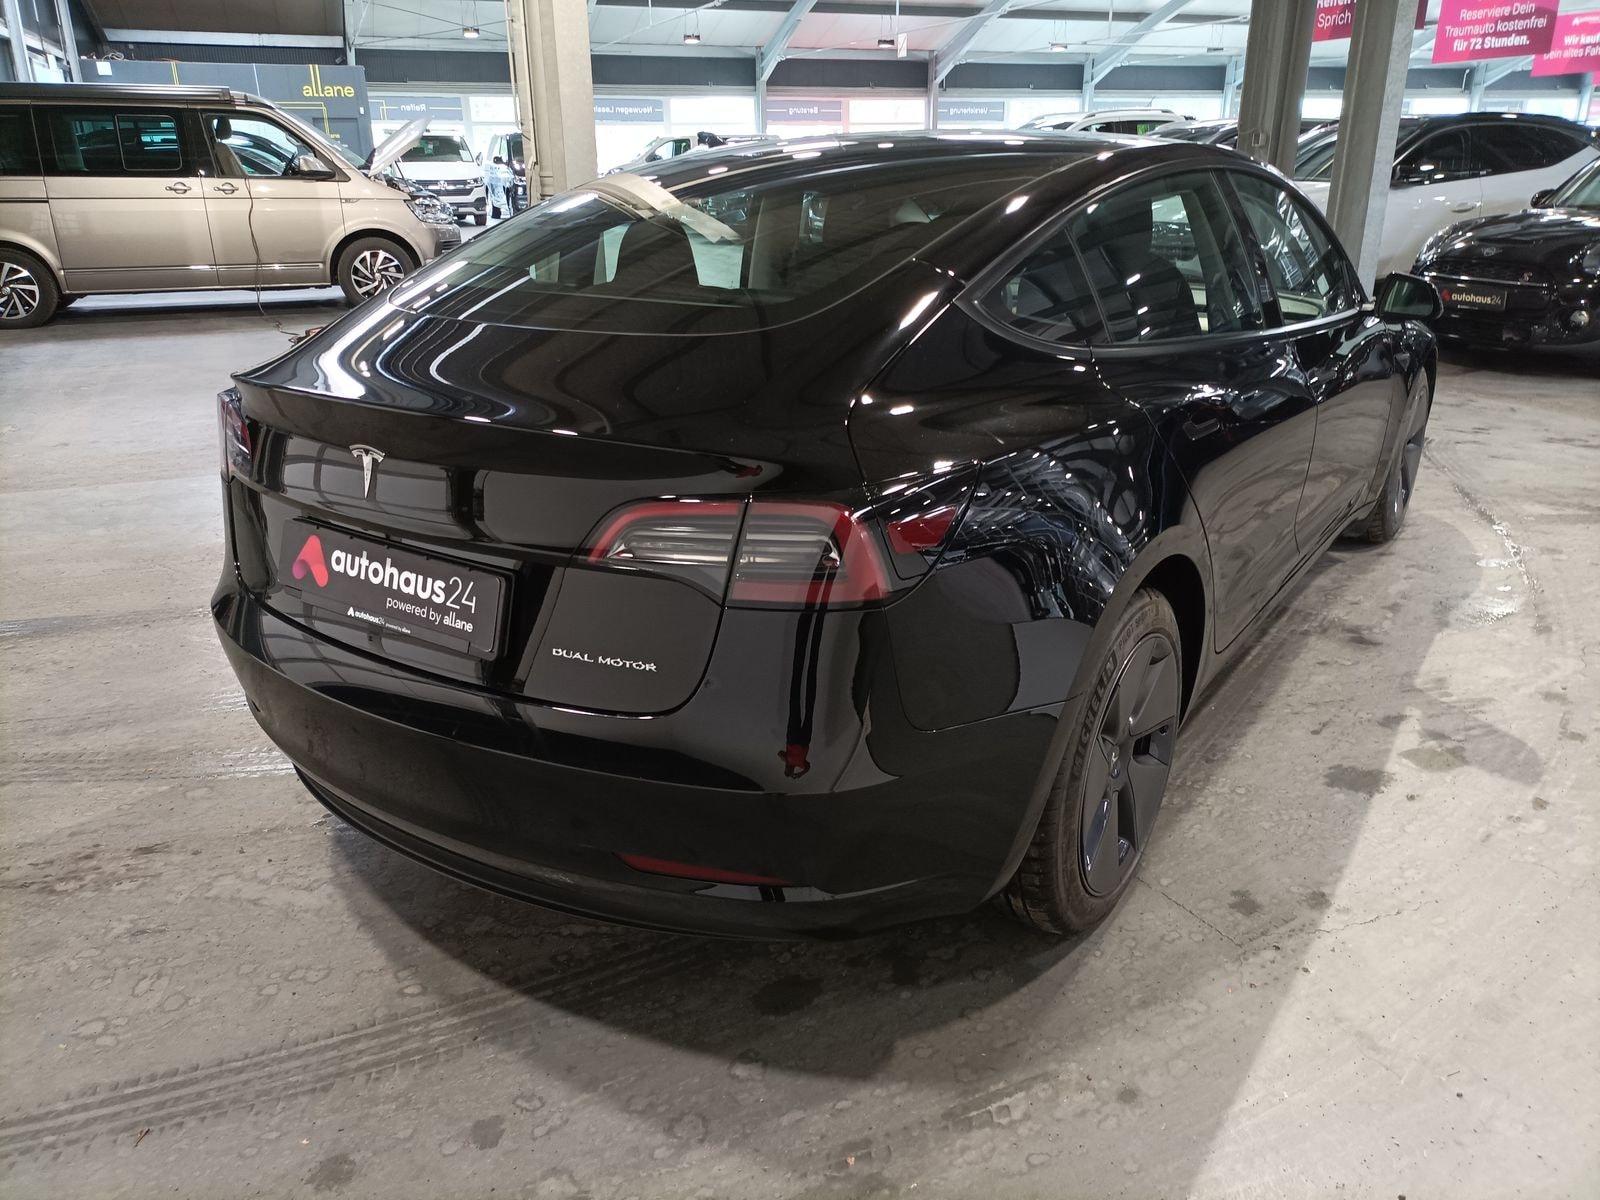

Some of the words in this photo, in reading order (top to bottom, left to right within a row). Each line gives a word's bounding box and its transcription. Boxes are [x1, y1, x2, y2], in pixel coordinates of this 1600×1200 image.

[1317, 9, 1352, 29] Sprich
[1460, 8, 1511, 21] Reserviere
[1512, 2, 1536, 15] Dein
[1445, 23, 1495, 38] Traumauto
[1496, 15, 1547, 32] kostenfrei
[1453, 38, 1467, 52] für
[1470, 37, 1482, 49] 72
[1484, 34, 1529, 48] Stunden.
[1564, 35, 1579, 45] Wir
[1563, 47, 1583, 58] altes
[1452, 292, 1502, 304] autohaus24
[331, 549, 477, 614] autohaus24
[386, 597, 428, 618] powered
[429, 608, 442, 624] by
[443, 611, 474, 633] allane
[552, 648, 594, 663] DUAL
[598, 656, 658, 672] MOTOR
